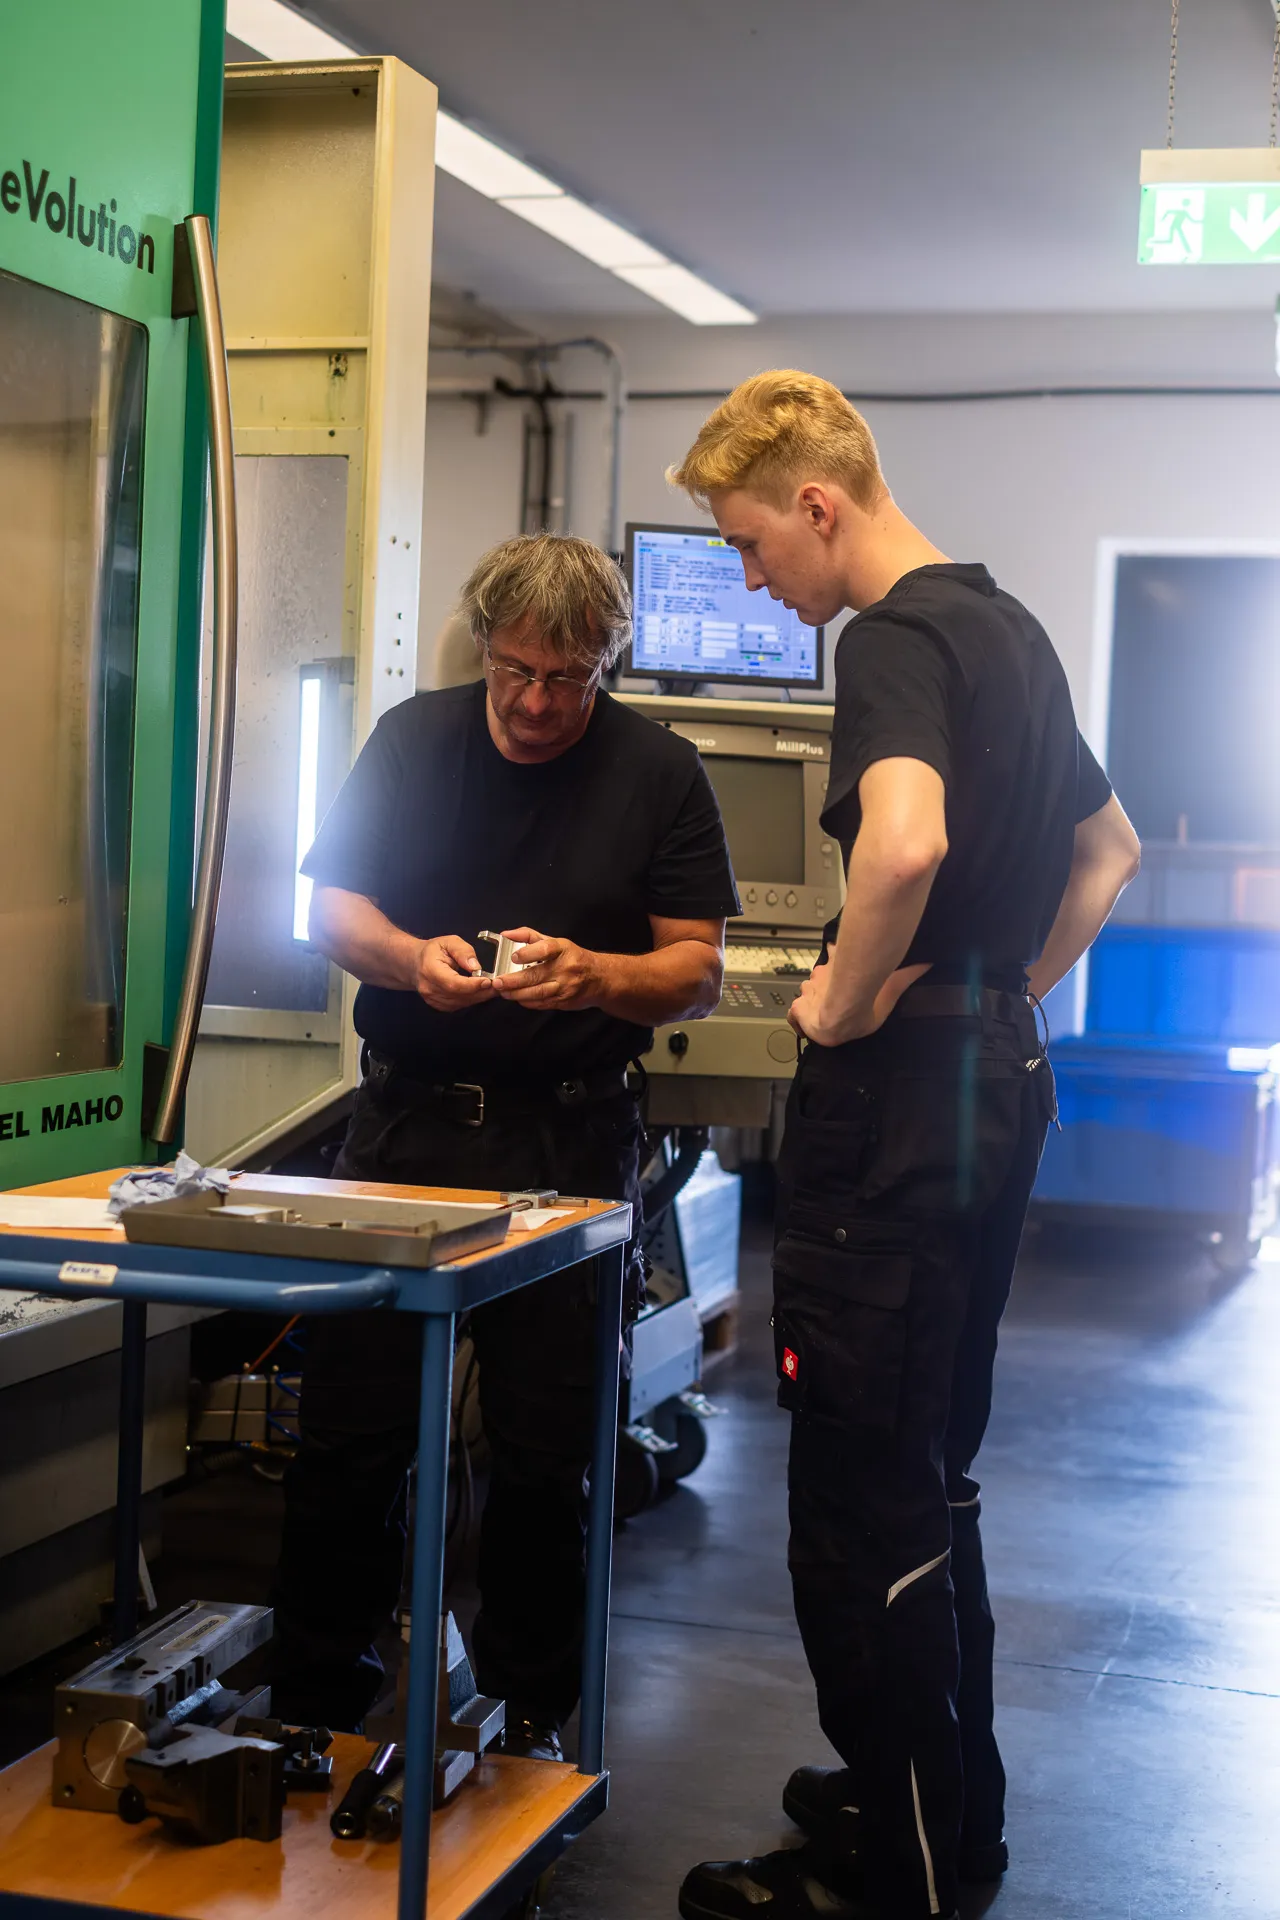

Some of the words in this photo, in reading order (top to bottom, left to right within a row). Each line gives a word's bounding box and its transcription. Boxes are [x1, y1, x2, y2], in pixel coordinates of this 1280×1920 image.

[1, 159, 155, 274] eVolution
[776, 740, 824, 755] MillPlus
[0, 1111, 30, 1141] EL
[41, 1094, 124, 1134] MAHO
